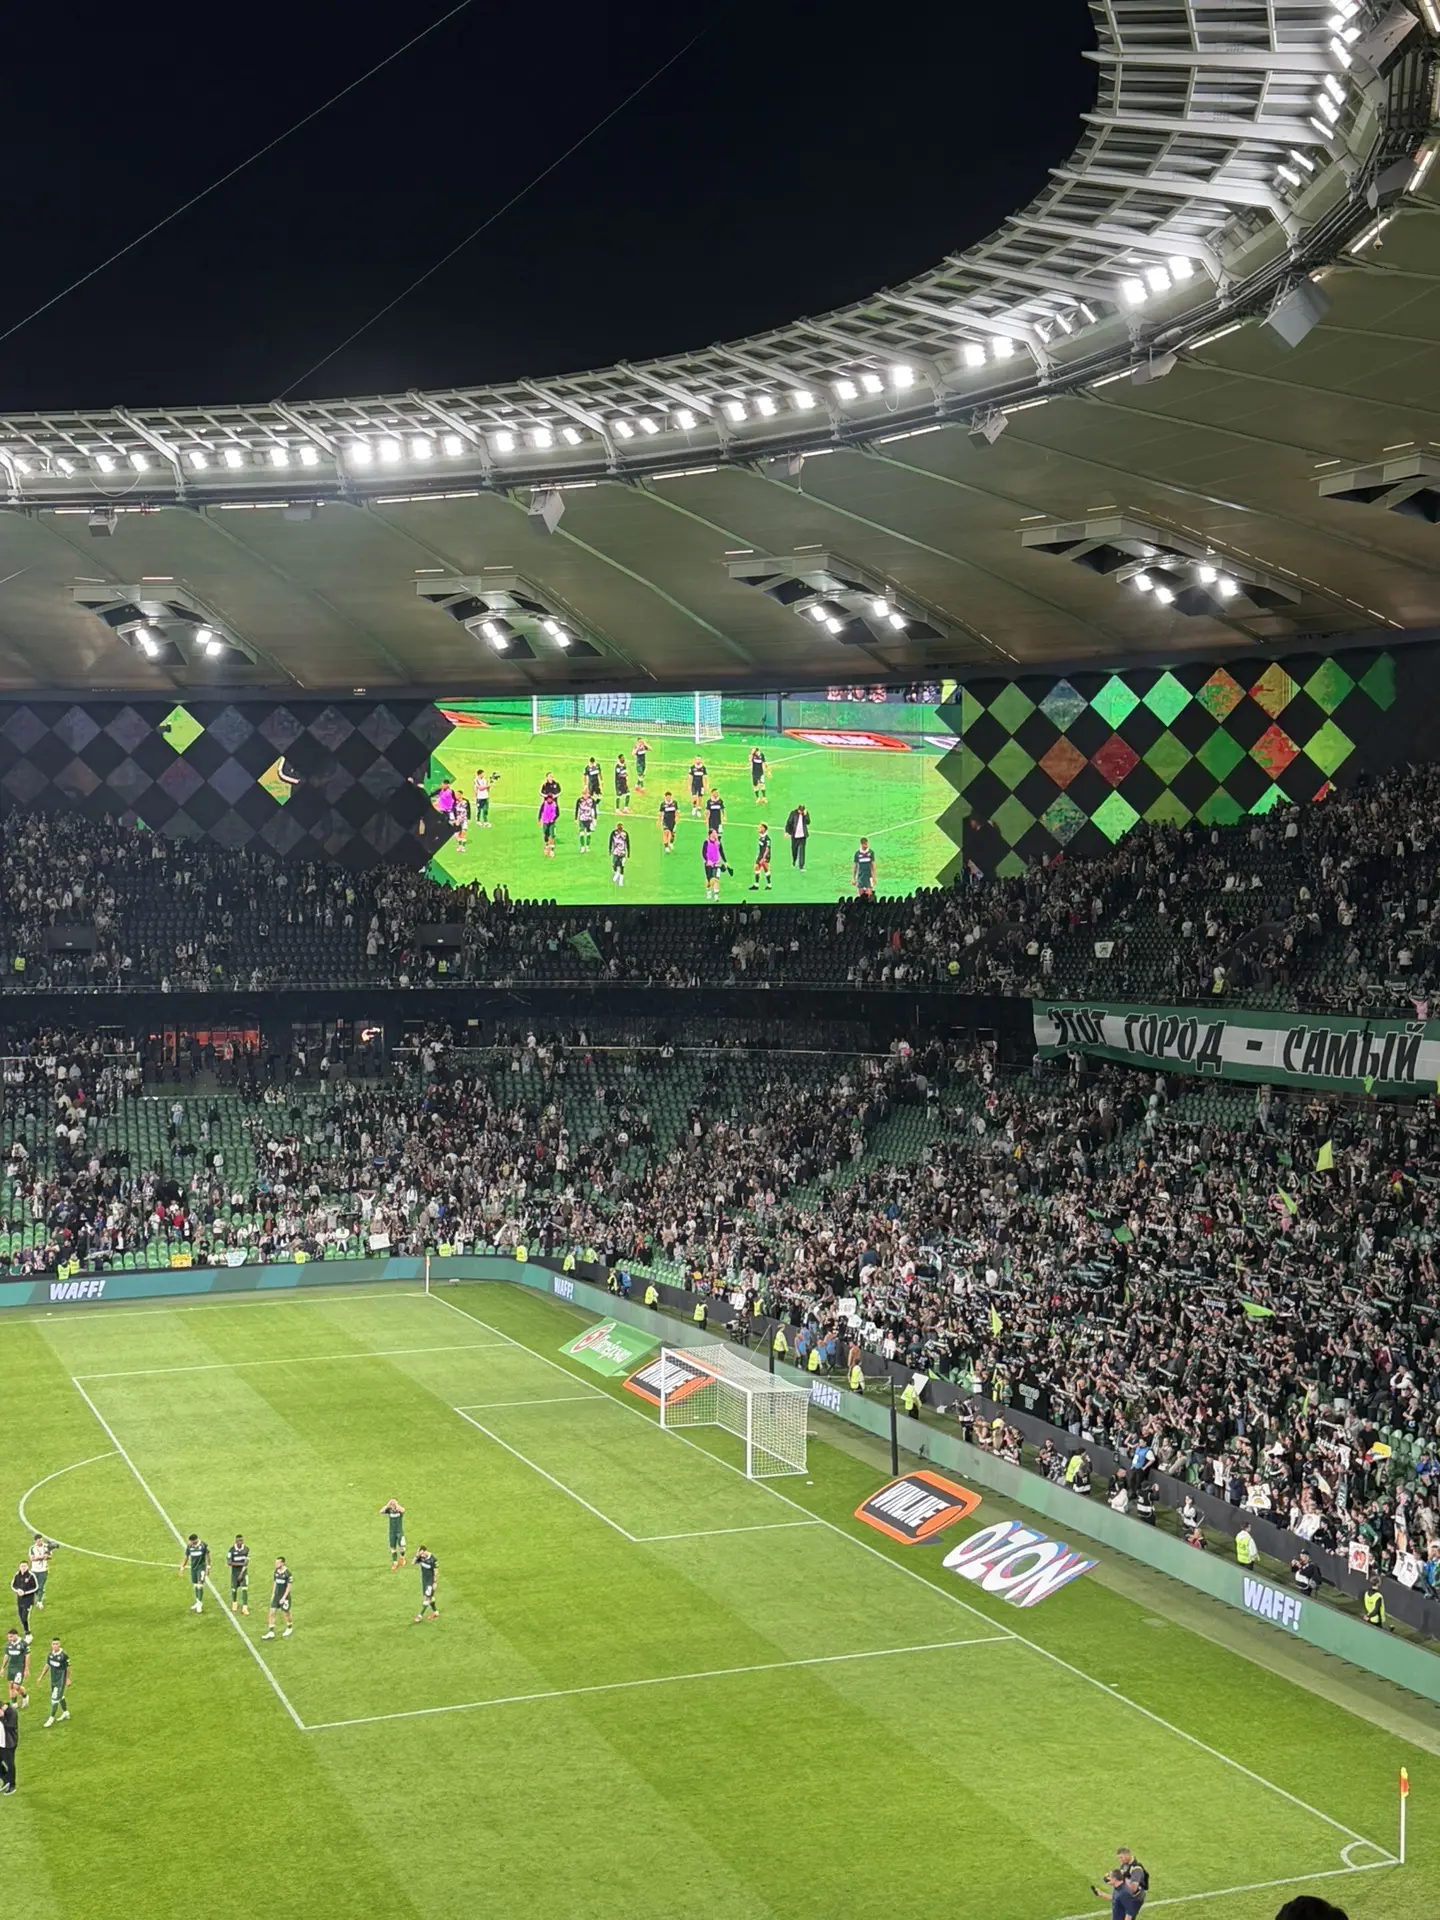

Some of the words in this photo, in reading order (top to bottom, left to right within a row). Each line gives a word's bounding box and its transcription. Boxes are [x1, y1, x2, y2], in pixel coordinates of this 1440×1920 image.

[584, 693, 631, 715] WAFF!
[1047, 1007, 1109, 1047] ЭТОТ
[1124, 1013, 1227, 1075] ГОРОД
[1282, 1021, 1427, 1084] САМЫЙ
[50, 1279, 106, 1301] WAFF!
[870, 1480, 951, 1528] WINLINE
[942, 1520, 1098, 1608] OZON
[1243, 1576, 1302, 1631] WAFF!
